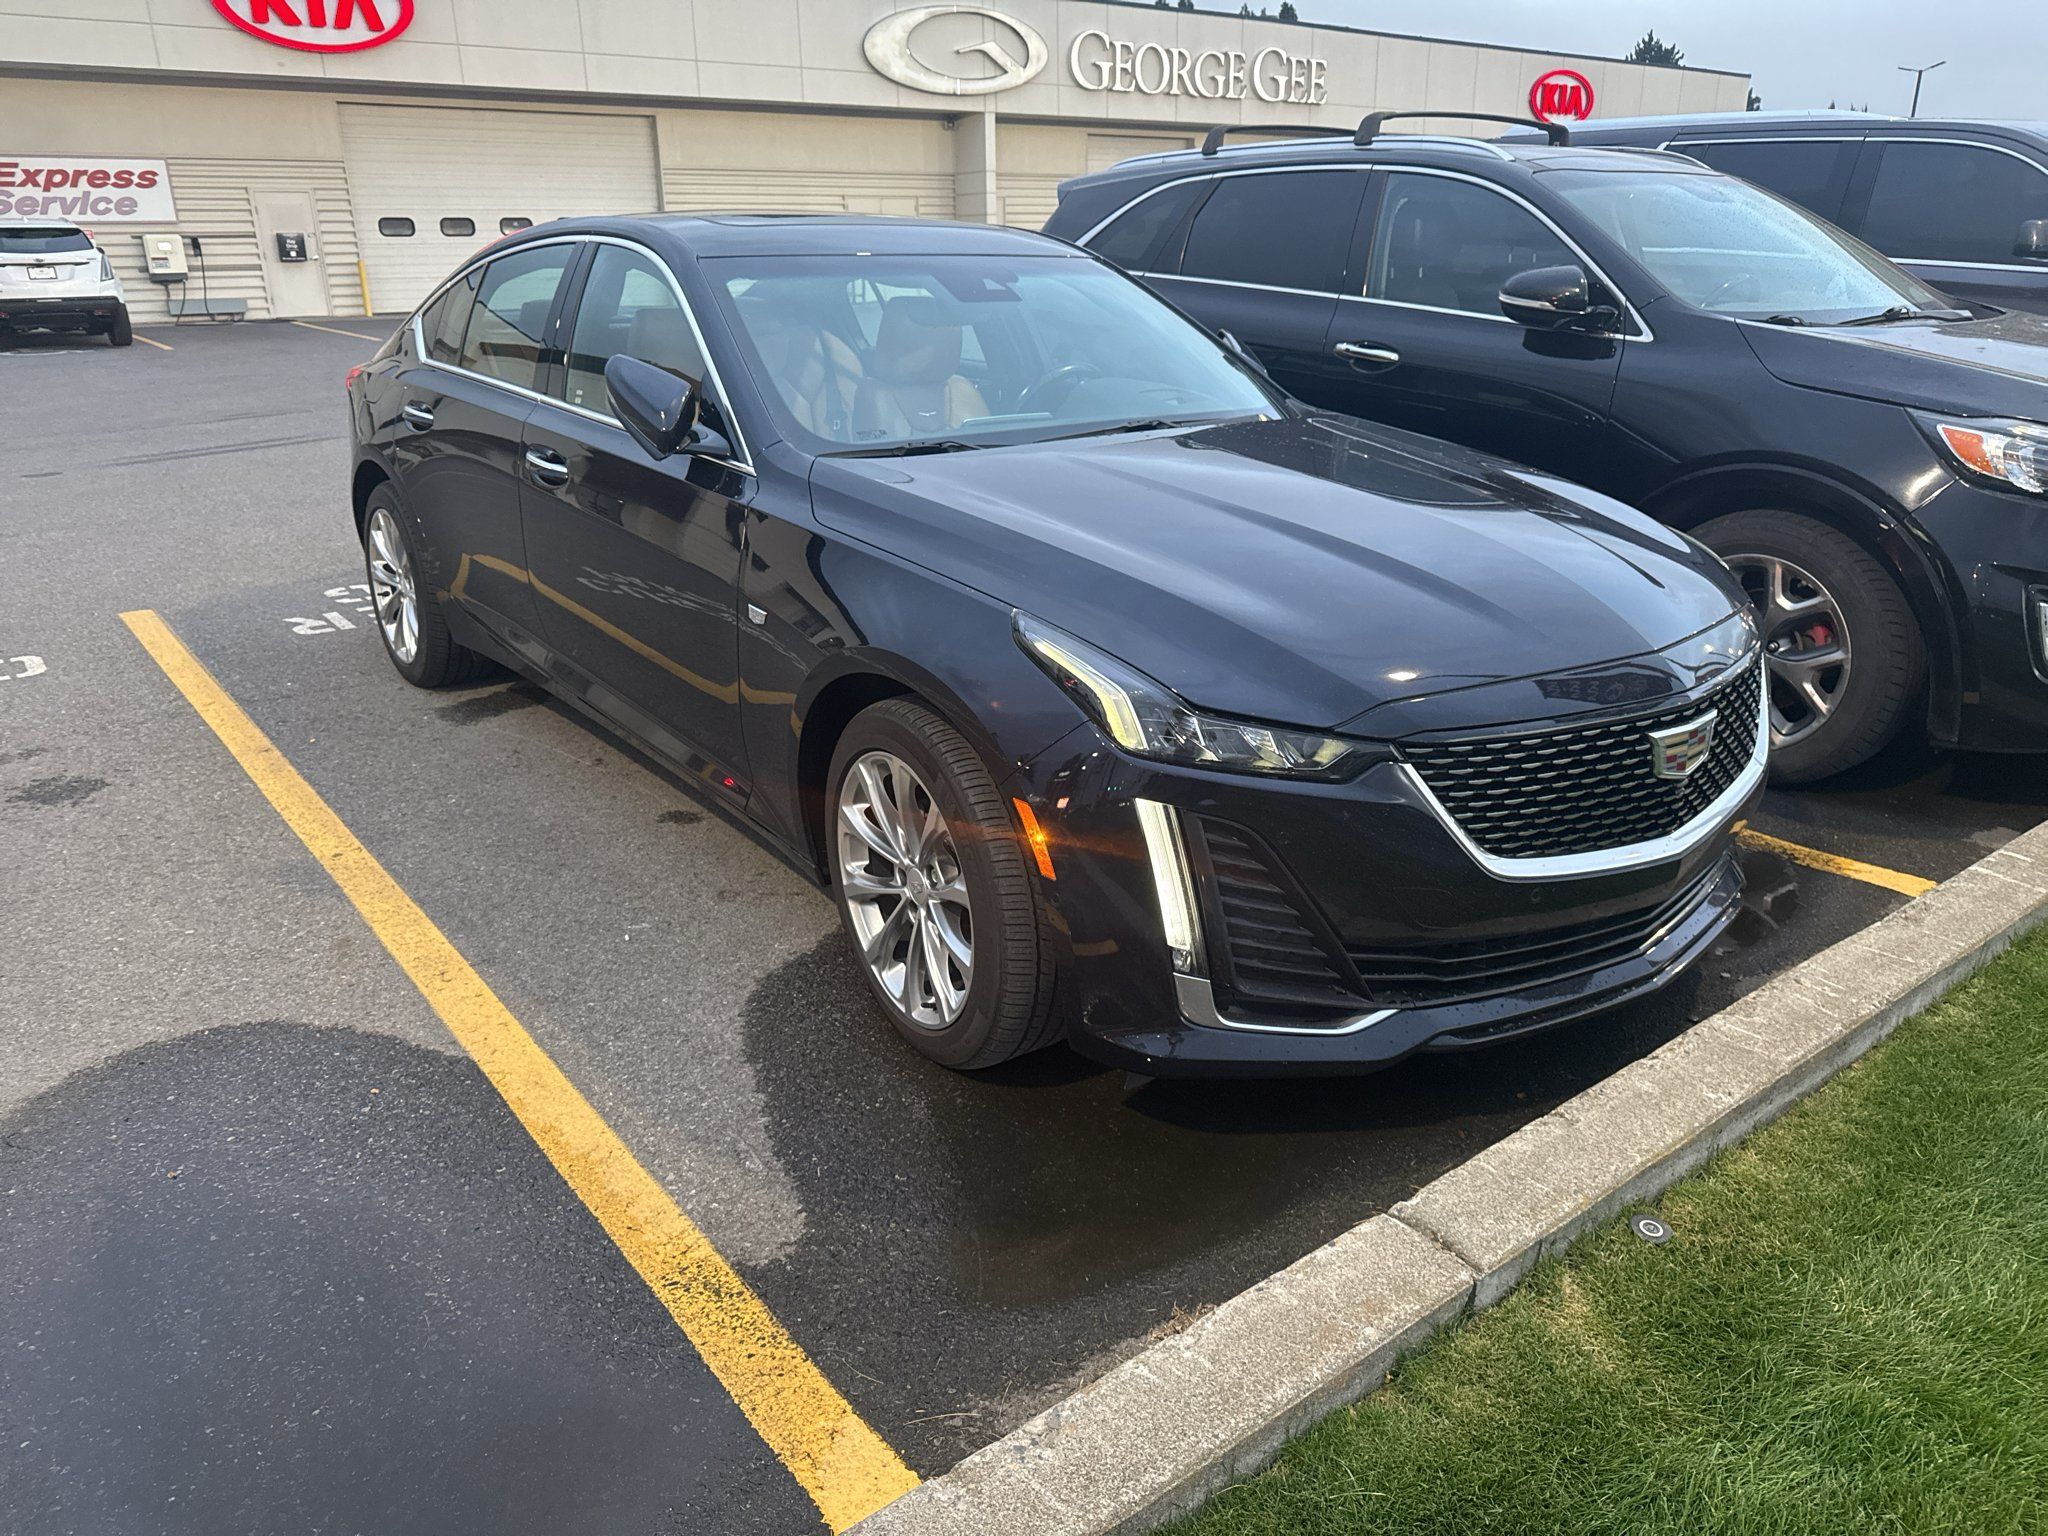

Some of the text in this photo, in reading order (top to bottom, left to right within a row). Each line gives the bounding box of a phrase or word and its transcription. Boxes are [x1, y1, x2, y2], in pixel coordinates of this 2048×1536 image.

[1070, 29, 1328, 105] GEORGE GEE
[1541, 83, 1583, 116] KIA
[0, 162, 159, 193] Express
